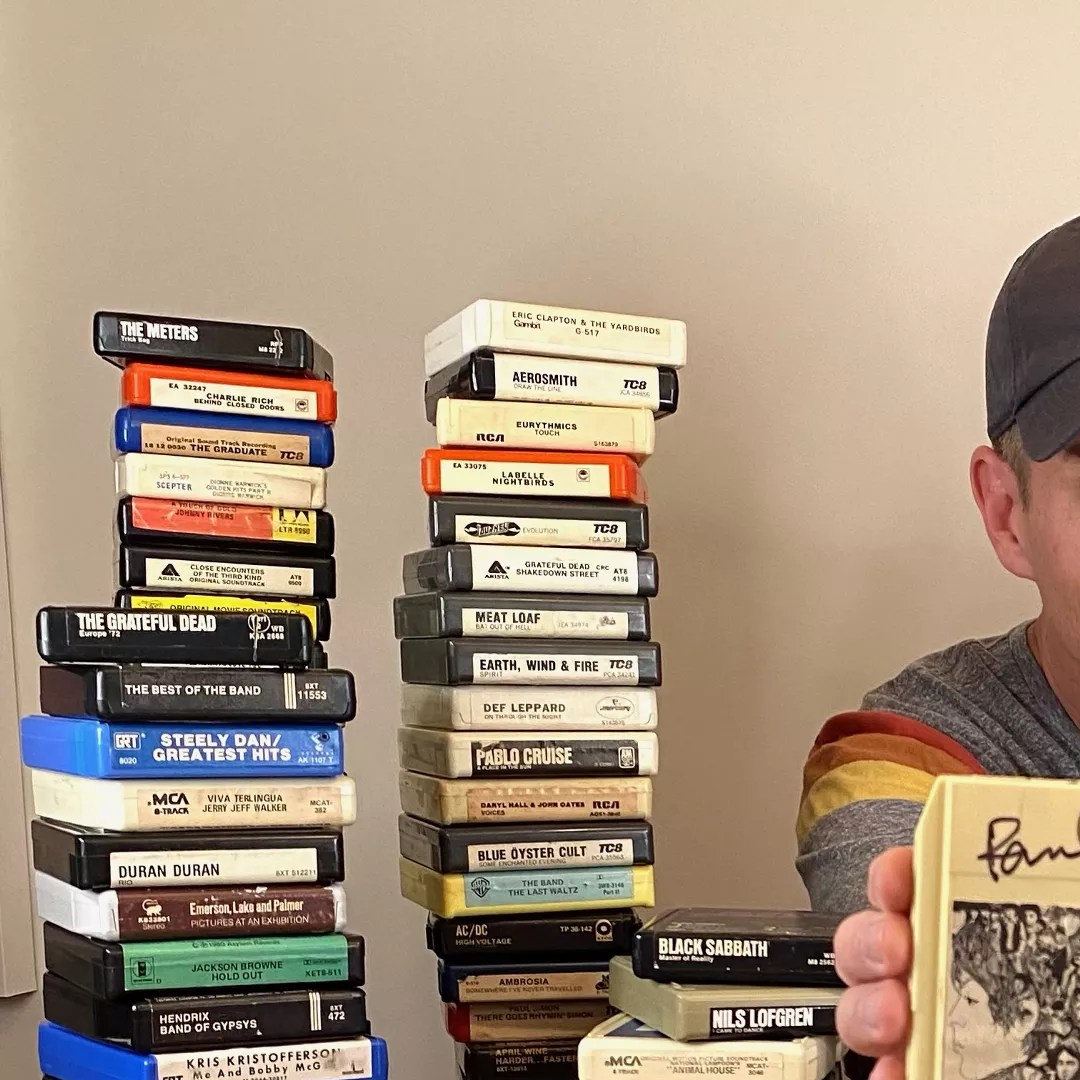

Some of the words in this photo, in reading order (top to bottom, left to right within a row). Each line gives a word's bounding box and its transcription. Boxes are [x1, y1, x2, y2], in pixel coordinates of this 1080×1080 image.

[512, 312, 533, 320] ERIC
[536, 313, 576, 324] CLAPTON
[590, 320, 607, 328] THE
[610, 323, 661, 335] YARDBIRDS
[120, 321, 144, 338] THE
[147, 323, 199, 341] METERS
[512, 372, 578, 386] AEROSMITH
[623, 380, 647, 390] TC8
[206, 393, 247, 403] CHARLIE
[252, 397, 274, 405] RICH
[516, 422, 578, 430] EURYTHMICS
[190, 444, 210, 452] THE
[214, 445, 268, 457] GRADUATE
[492, 478, 554, 486] NIGHTBIRDS
[502, 472, 544, 480] LABELLE
[77, 613, 104, 630] THE
[107, 613, 176, 631] GRATEFUL
[179, 614, 216, 632] DEAD
[476, 612, 508, 624] MEAT
[512, 613, 541, 624] LOAF
[480, 660, 520, 672] EARTH,
[526, 660, 556, 671] WIND
[560, 661, 569, 671] &
[574, 661, 599, 672] FIRE
[609, 660, 633, 669] TC8
[125, 685, 149, 694] THE
[152, 685, 182, 695] BEST
[186, 685, 200, 695] OF
[204, 685, 227, 695] THE
[230, 686, 261, 695] BAND
[484, 704, 506, 713] DEF
[511, 704, 566, 713] LEPPARD
[161, 734, 230, 747] STEELY
[235, 734, 281, 746] DAN/
[153, 748, 246, 761] GREATEST
[252, 748, 291, 761] HITS
[476, 748, 520, 766] PABLO
[523, 748, 572, 764] CRUISE
[152, 793, 189, 805] MCA
[234, 794, 282, 802] TERLINGUA
[478, 848, 507, 861] BLUE
[511, 846, 554, 860] ÖYSTER
[559, 846, 587, 859] CULT
[119, 865, 167, 878] DURAN
[174, 864, 220, 877] DURAN
[456, 924, 489, 937] AC/DC
[659, 938, 702, 956] BLACK
[705, 939, 768, 958] SABBATH
[192, 962, 238, 972] JACKSON
[241, 961, 283, 971] BROWNE
[212, 972, 240, 981] HOLD
[242, 971, 263, 980] OUT
[160, 1012, 209, 1024] HENDRIX
[712, 1008, 746, 1029] NILS
[749, 1008, 814, 1028] LOFGREN
[160, 1023, 191, 1034] BAND
[194, 1022, 210, 1032] OF
[212, 1020, 257, 1032] GYPSYS
